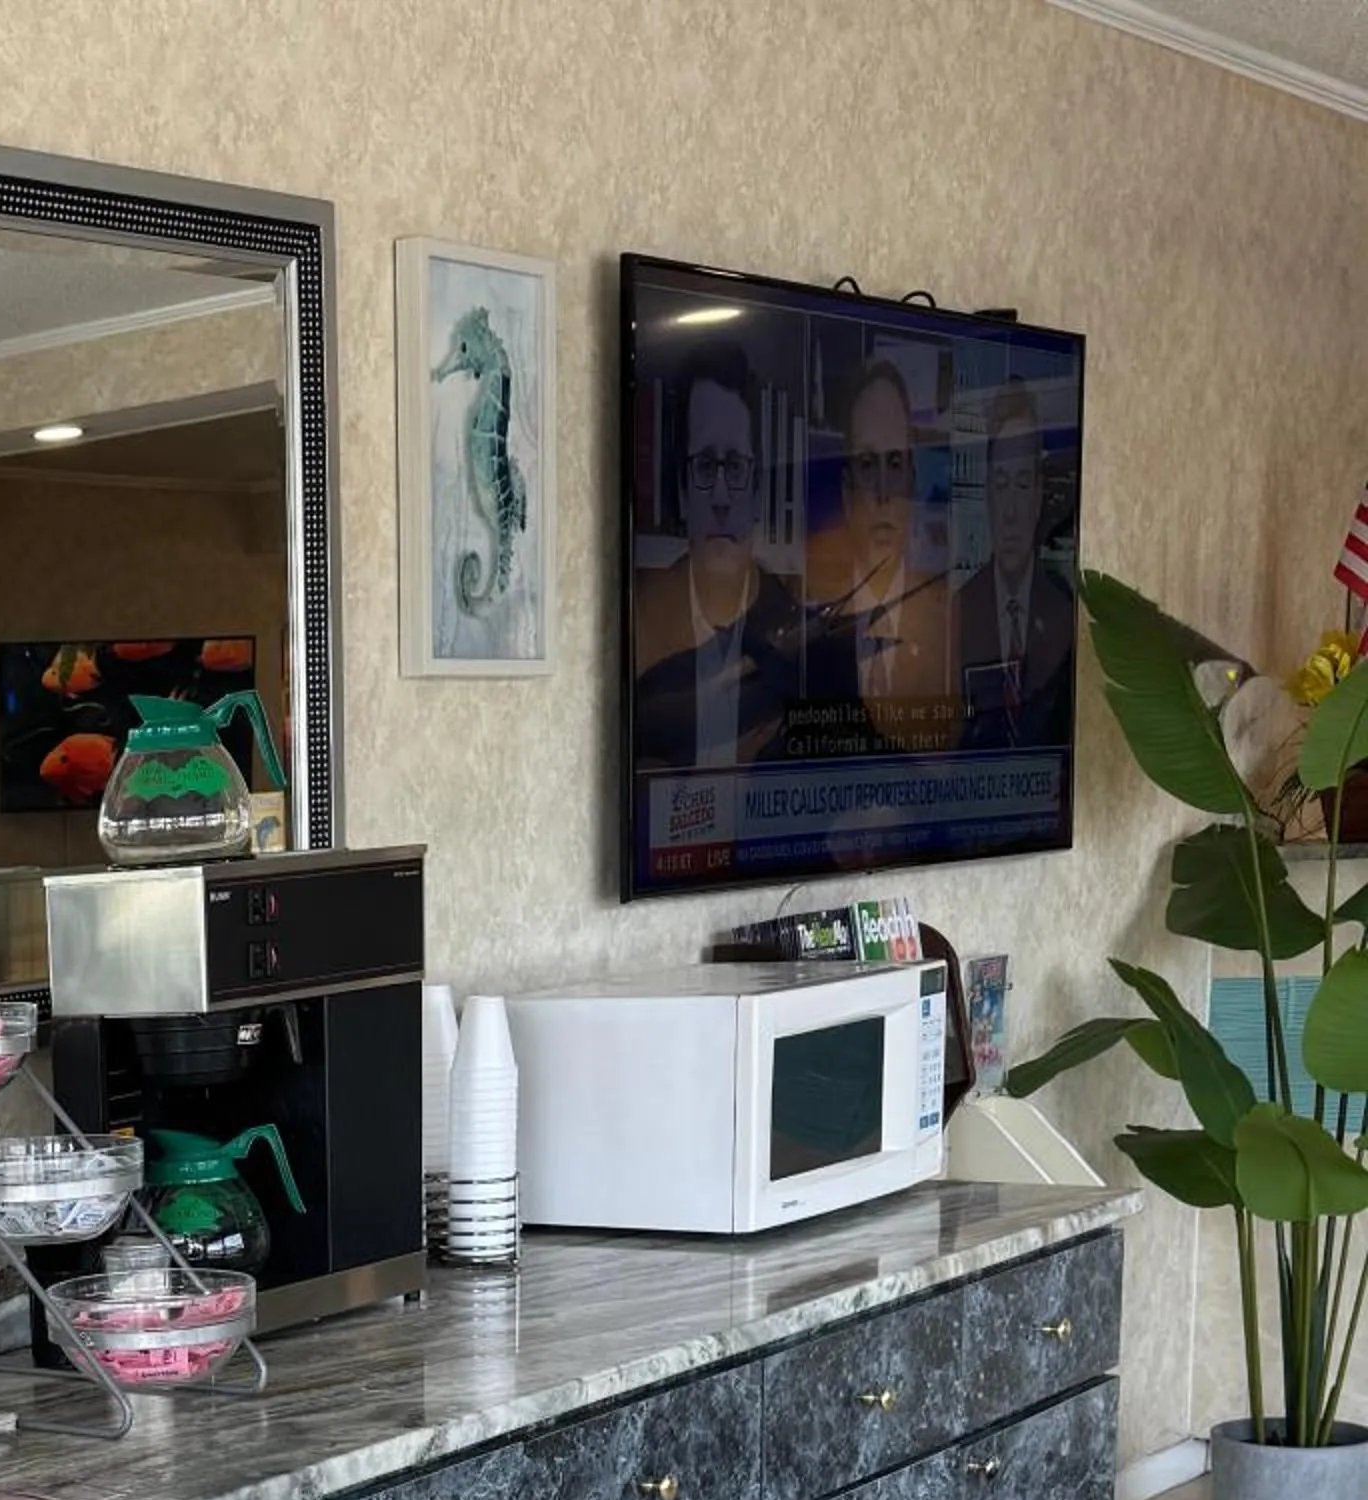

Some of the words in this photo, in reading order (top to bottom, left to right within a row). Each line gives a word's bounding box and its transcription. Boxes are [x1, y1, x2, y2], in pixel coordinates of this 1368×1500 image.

[786, 734, 867, 755] California
[745, 788, 789, 821] MILLER
[790, 784, 827, 816] CALLS
[828, 781, 855, 814] OUT
[855, 778, 919, 812] REPORTERS
[919, 773, 986, 808] DEMANDING
[987, 773, 1008, 801] DUE
[1009, 770, 1052, 798] PROCESS
[706, 847, 731, 868] LIVE
